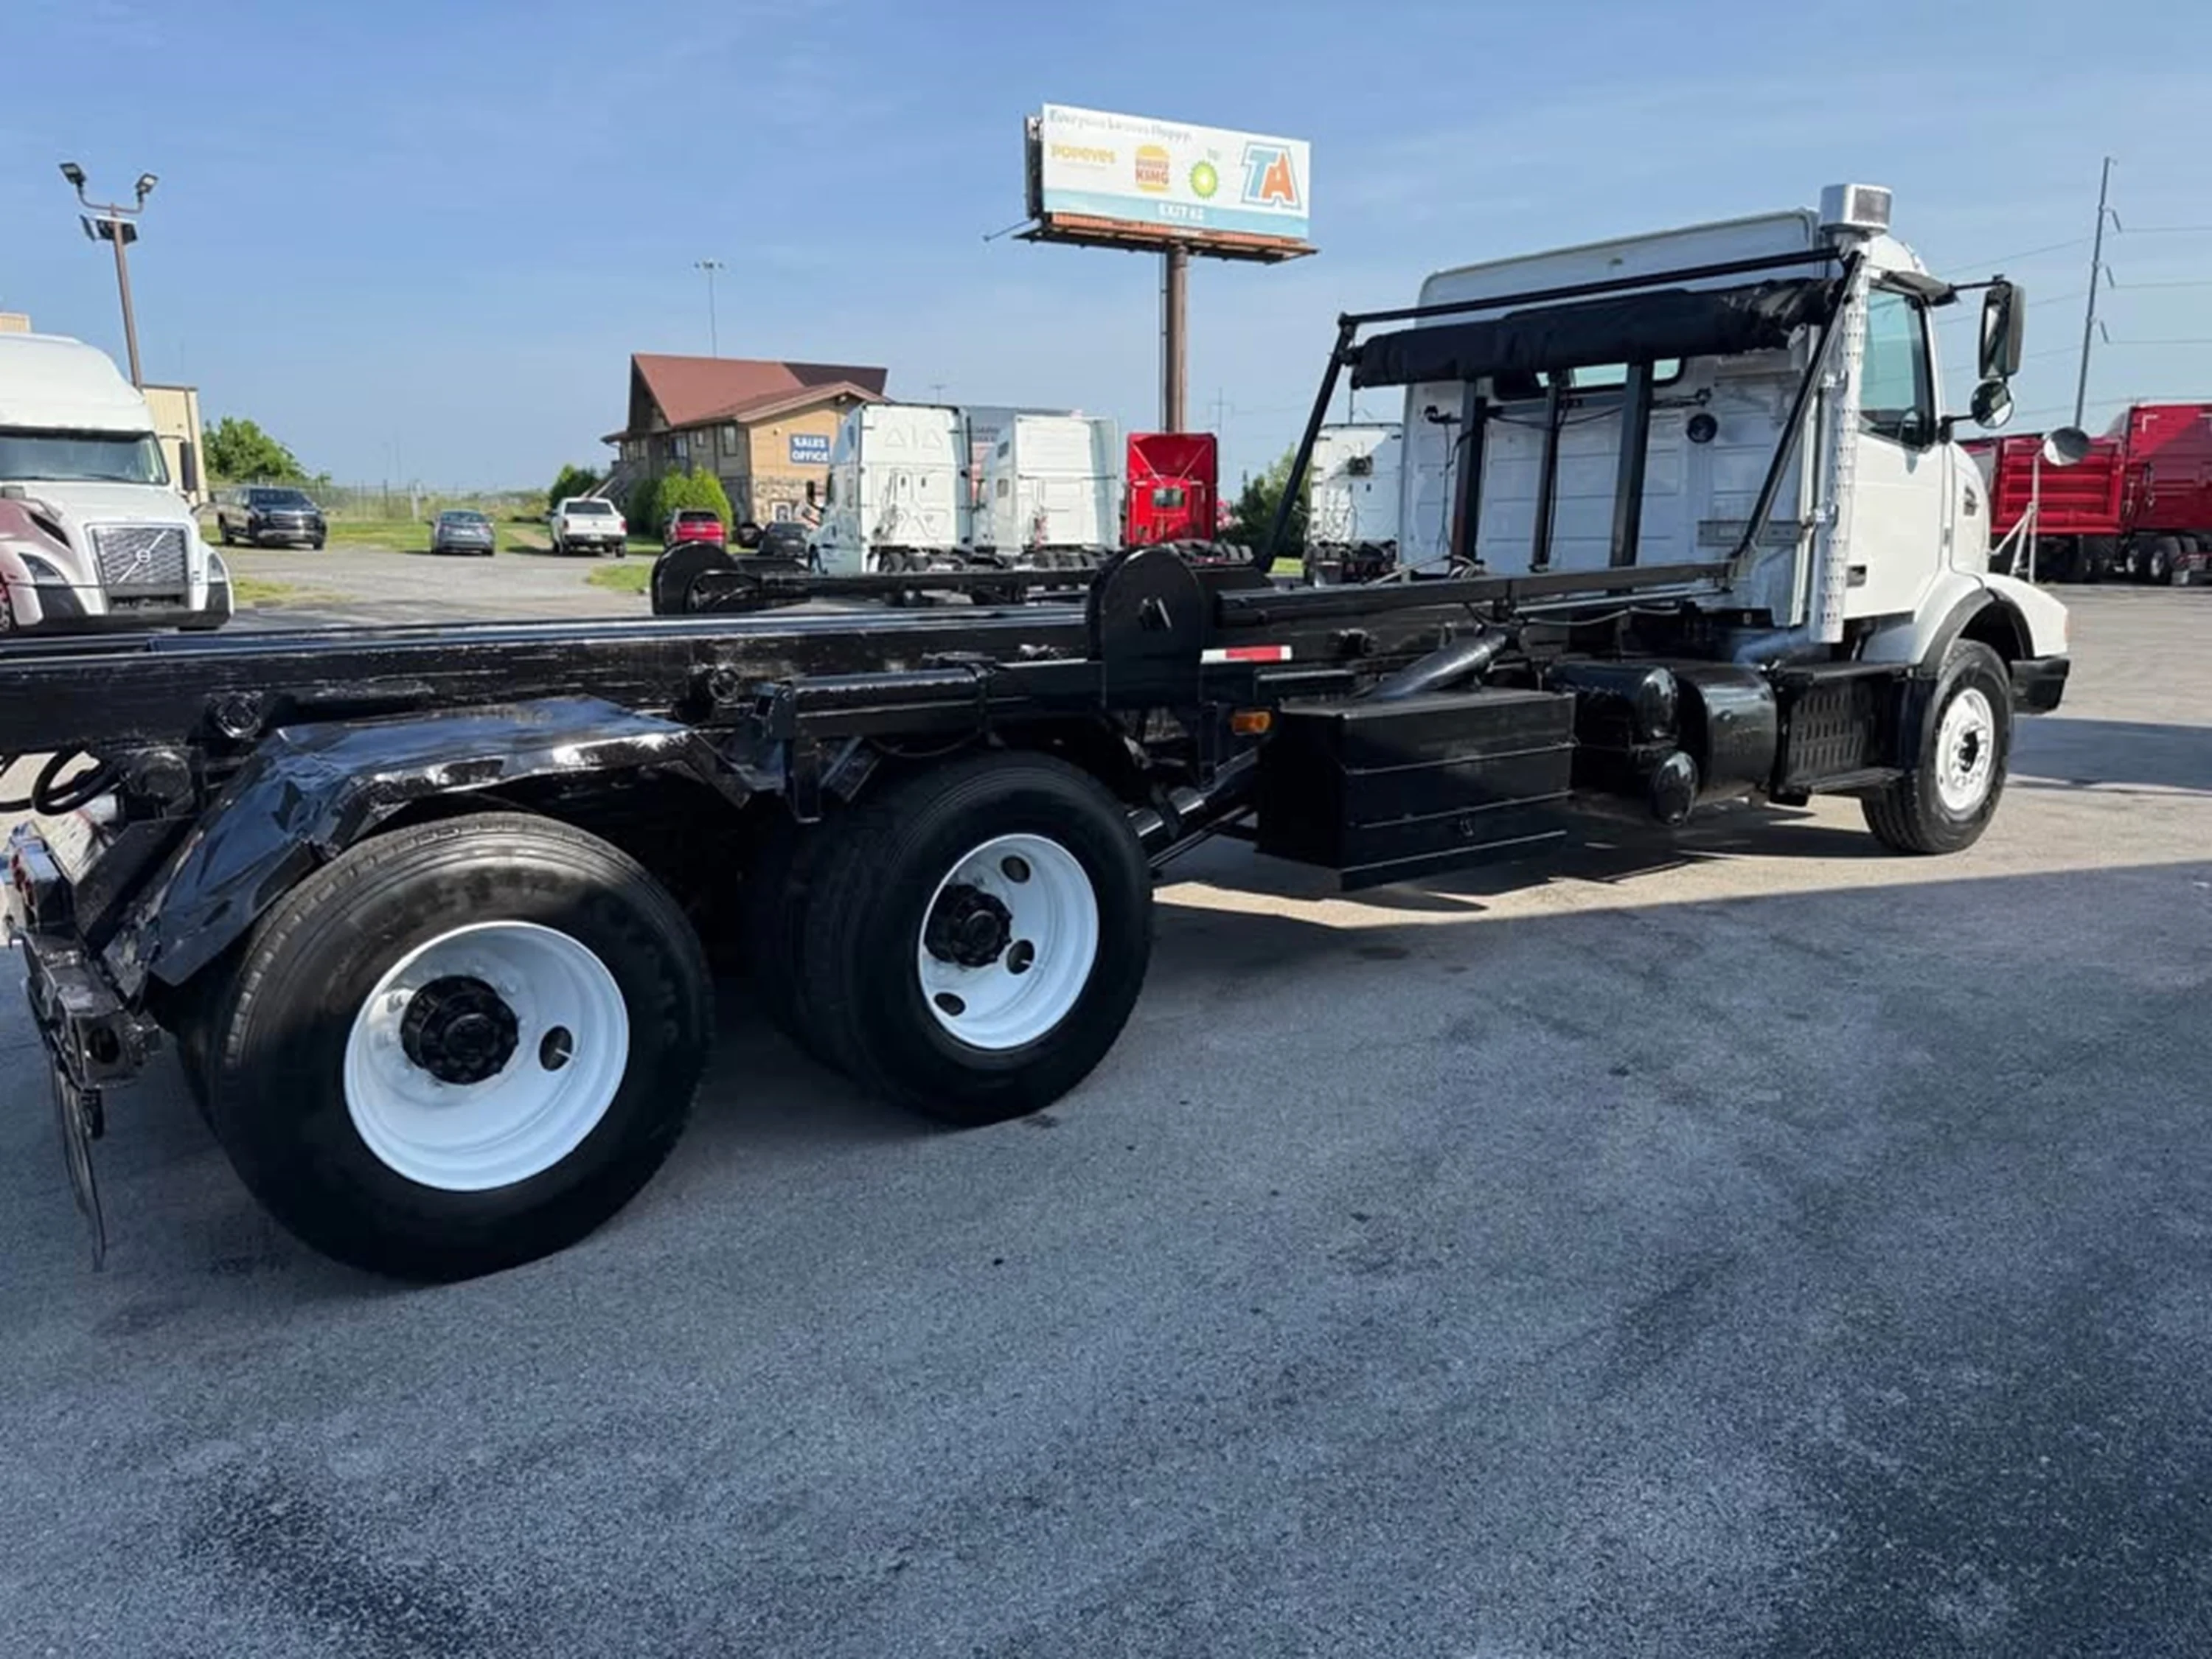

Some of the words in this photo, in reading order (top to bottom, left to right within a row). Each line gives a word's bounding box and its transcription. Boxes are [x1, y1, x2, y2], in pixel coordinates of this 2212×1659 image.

[1135, 167, 1169, 185] KING
[1244, 145, 1298, 206] TA
[793, 437, 826, 448] SALES
[792, 449, 828, 462] OFFICE
